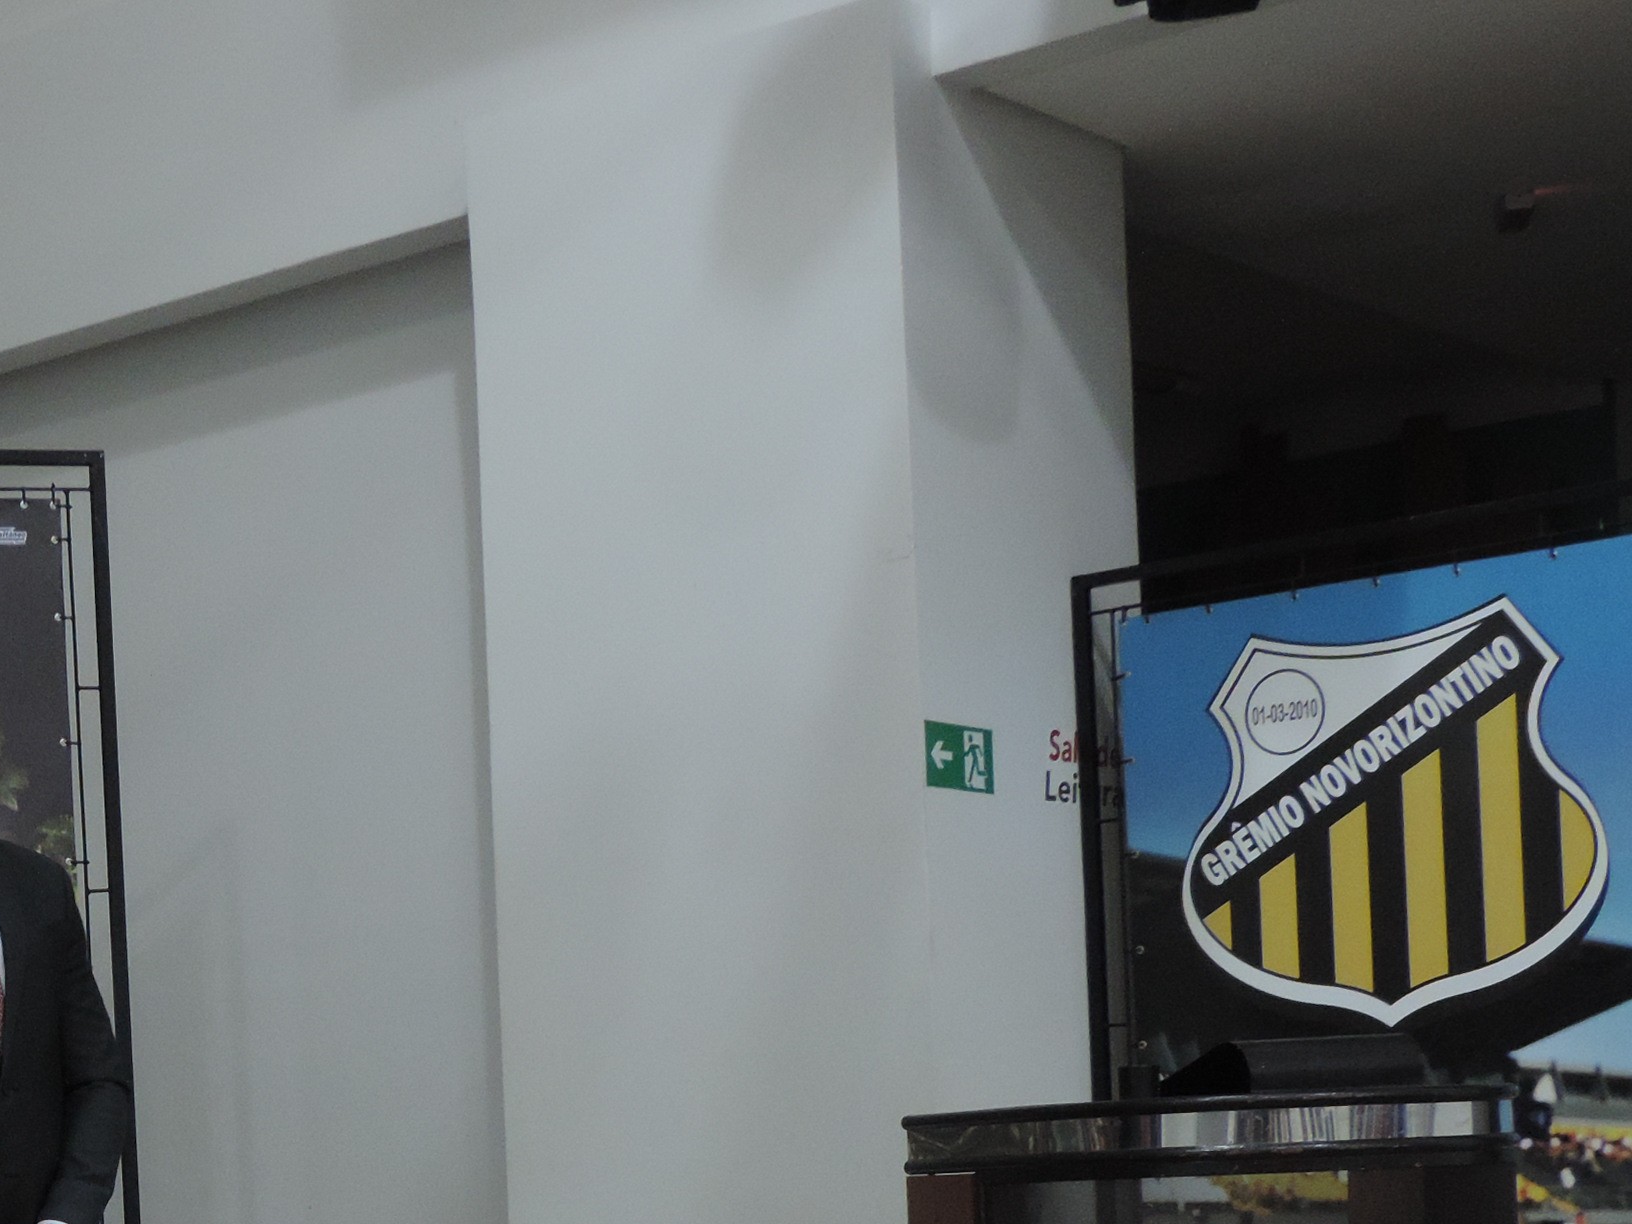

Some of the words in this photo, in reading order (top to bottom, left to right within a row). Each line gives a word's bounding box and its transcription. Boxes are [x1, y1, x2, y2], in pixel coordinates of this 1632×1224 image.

[1201, 795, 1305, 886] GRÊMIO
[1299, 635, 1520, 815] NOVORIZONTINO
[1252, 698, 1318, 726] 01-03-2010
